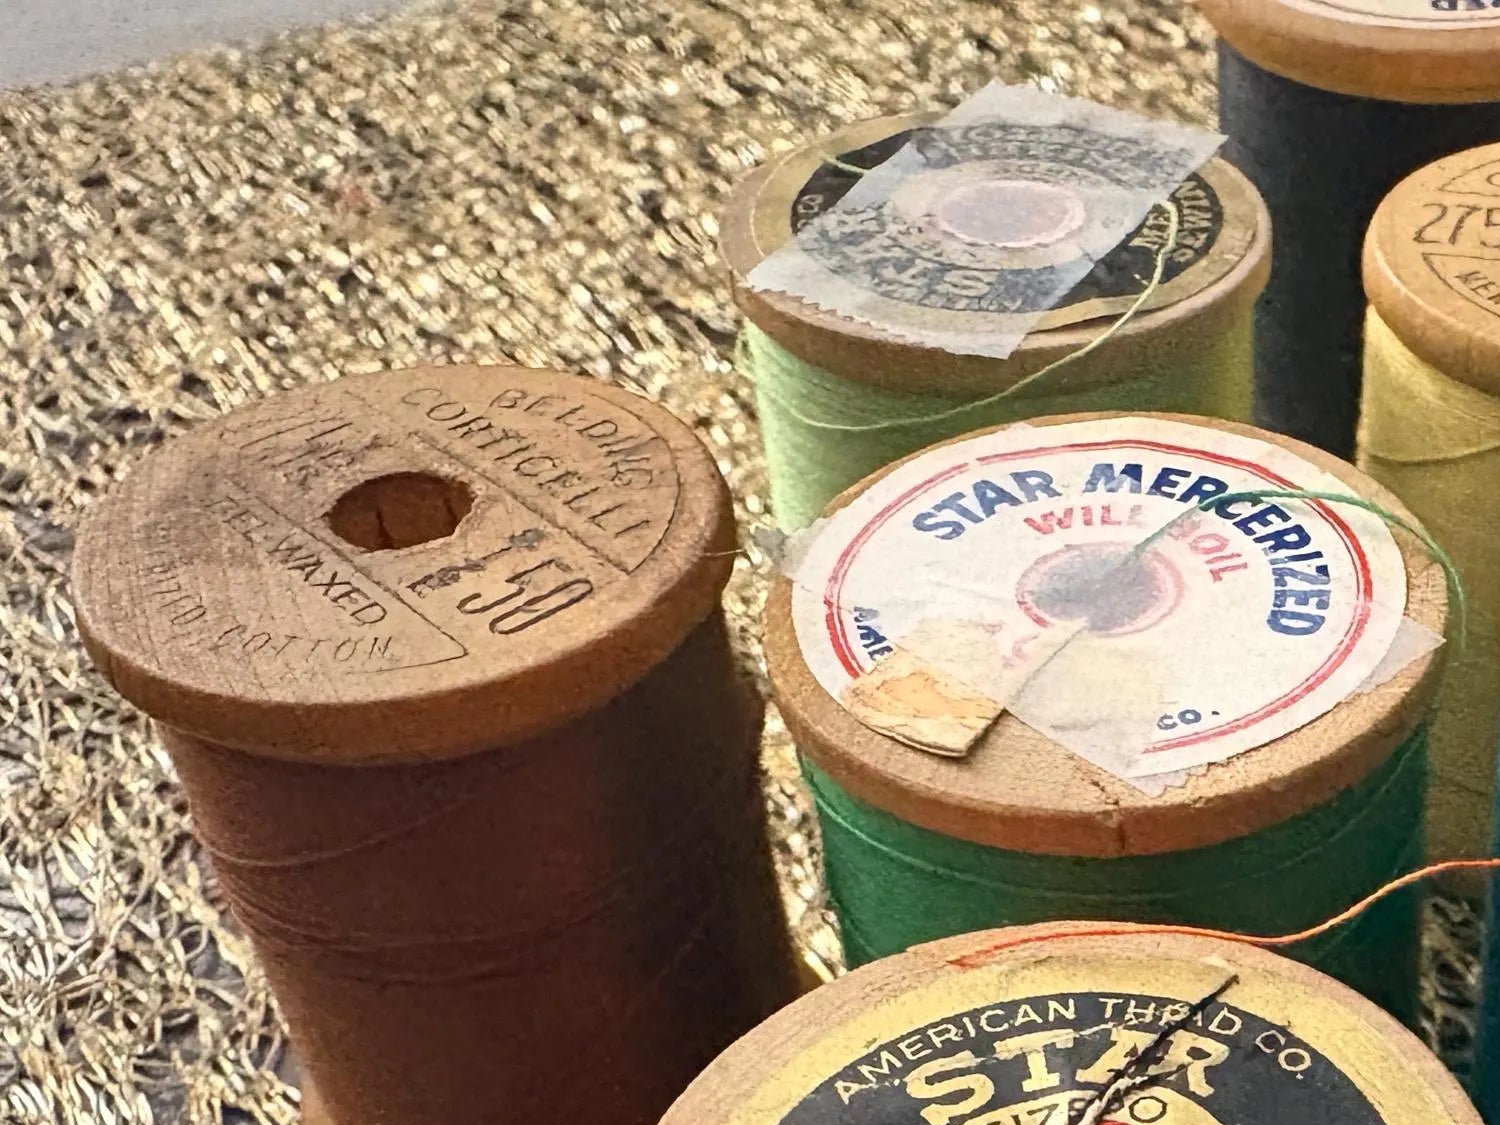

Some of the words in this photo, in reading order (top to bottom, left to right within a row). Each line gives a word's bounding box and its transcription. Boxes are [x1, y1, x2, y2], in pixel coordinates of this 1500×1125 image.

[457, 558, 595, 636] 50
[912, 467, 1062, 541] STAR
[1082, 462, 1333, 636] MERCERIZED
[835, 997, 1076, 1107] AMERICAN
